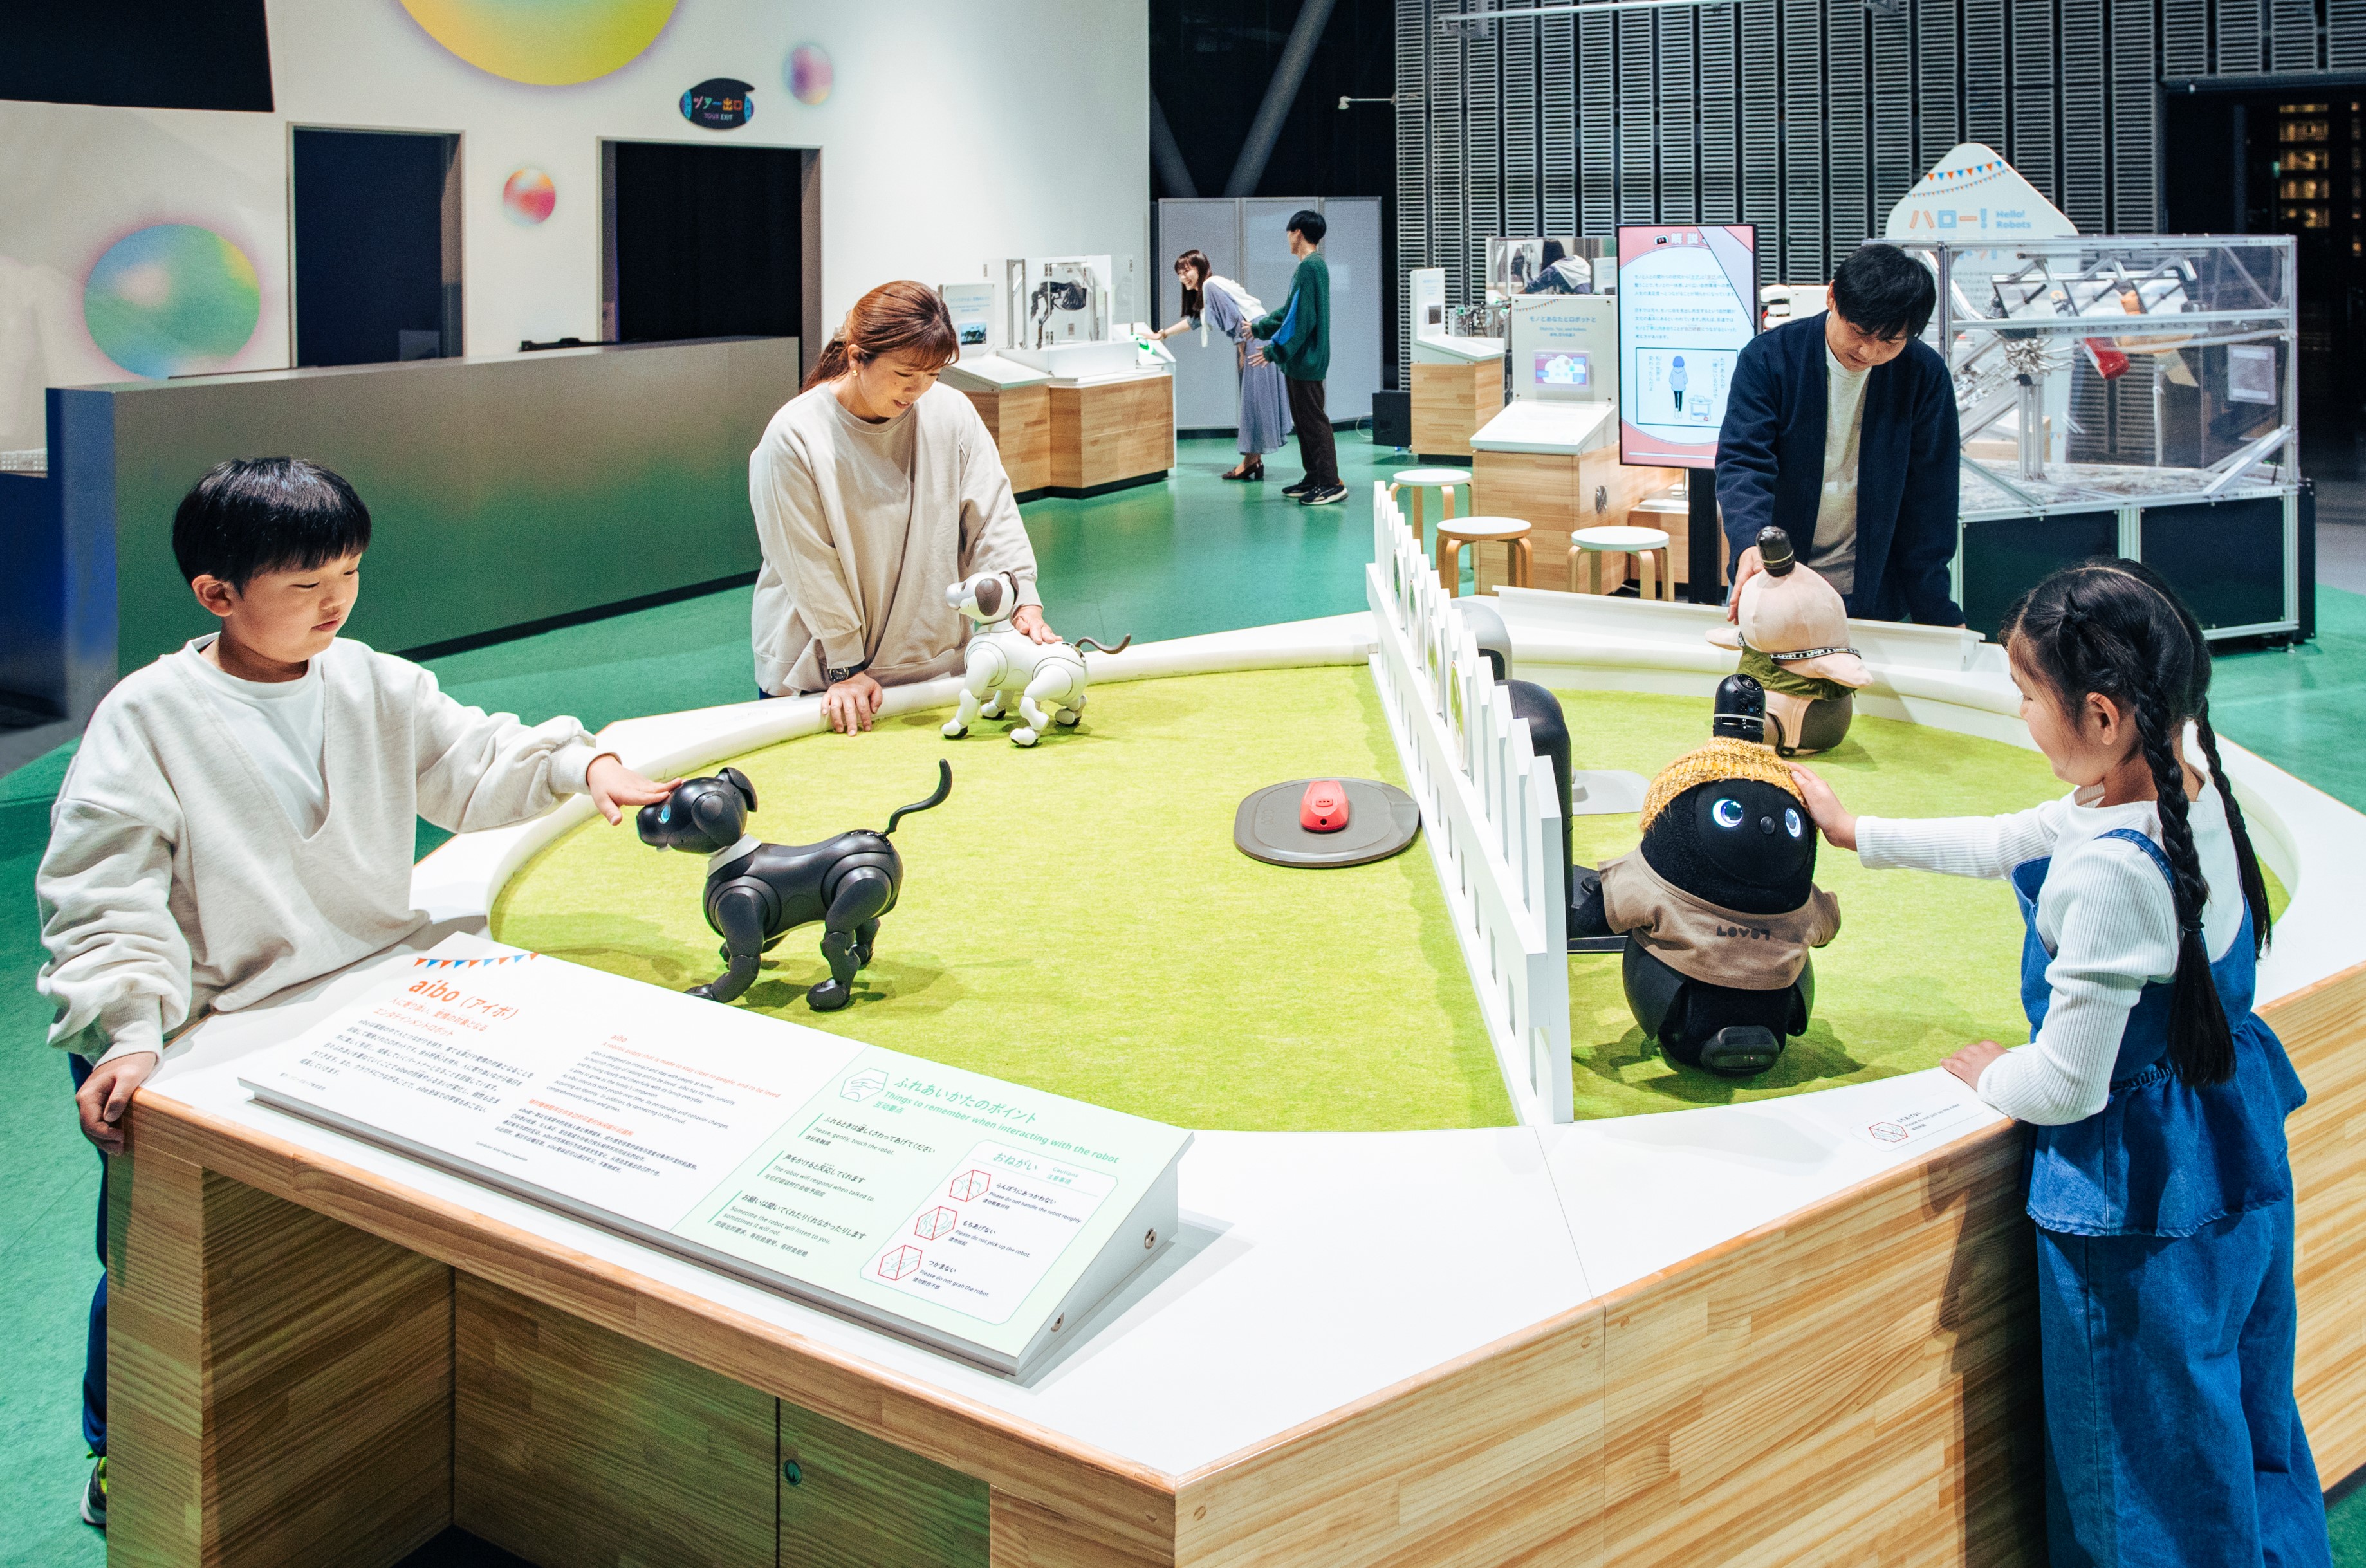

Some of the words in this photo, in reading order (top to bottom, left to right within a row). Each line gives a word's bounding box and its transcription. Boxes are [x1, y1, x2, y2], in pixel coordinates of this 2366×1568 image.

[693, 95, 743, 111] ツアー出口
[1996, 210, 2026, 219] Hello!
[1996, 219, 2031, 229] Robots
[407, 979, 460, 1002] aibo
[609, 1034, 628, 1043] aibo
[892, 1076, 1036, 1124] ふれあいかたのポイント
[812, 1126, 831, 1136] Please,
[850, 1138, 868, 1147] touch
[822, 1116, 936, 1153] ふれるときは優しくさわってあげてください
[883, 1090, 913, 1105] Things
[923, 1103, 972, 1121] remember
[970, 1116, 997, 1129] when
[996, 1123, 1050, 1145] interacting
[1049, 1139, 1073, 1150] with
[1072, 1145, 1091, 1156] the
[1090, 1150, 1120, 1164] robot
[782, 1153, 865, 1184] 声をかけると反応してくれます
[992, 1152, 1038, 1171] おねがい
[772, 1164, 784, 1172] The
[782, 1168, 800, 1177] robot
[808, 1177, 834, 1188] respond
[831, 1185, 849, 1194] when
[847, 1189, 868, 1199] talked
[1051, 1166, 1079, 1179] Cautions
[987, 1190, 1005, 1200] Please
[1019, 1201, 1039, 1210] handle
[722, 1212, 753, 1227] sometimes
[729, 1204, 758, 1219] Sometime
[766, 1219, 785, 1228] robot
[793, 1227, 812, 1237] listen
[740, 1194, 867, 1240] お願いは聞いてくれたりくれなかったりします
[962, 1219, 996, 1234] もちあげない
[954, 1228, 972, 1239] Please
[918, 1268, 936, 1278] Please
[928, 1260, 957, 1273] つかまない
